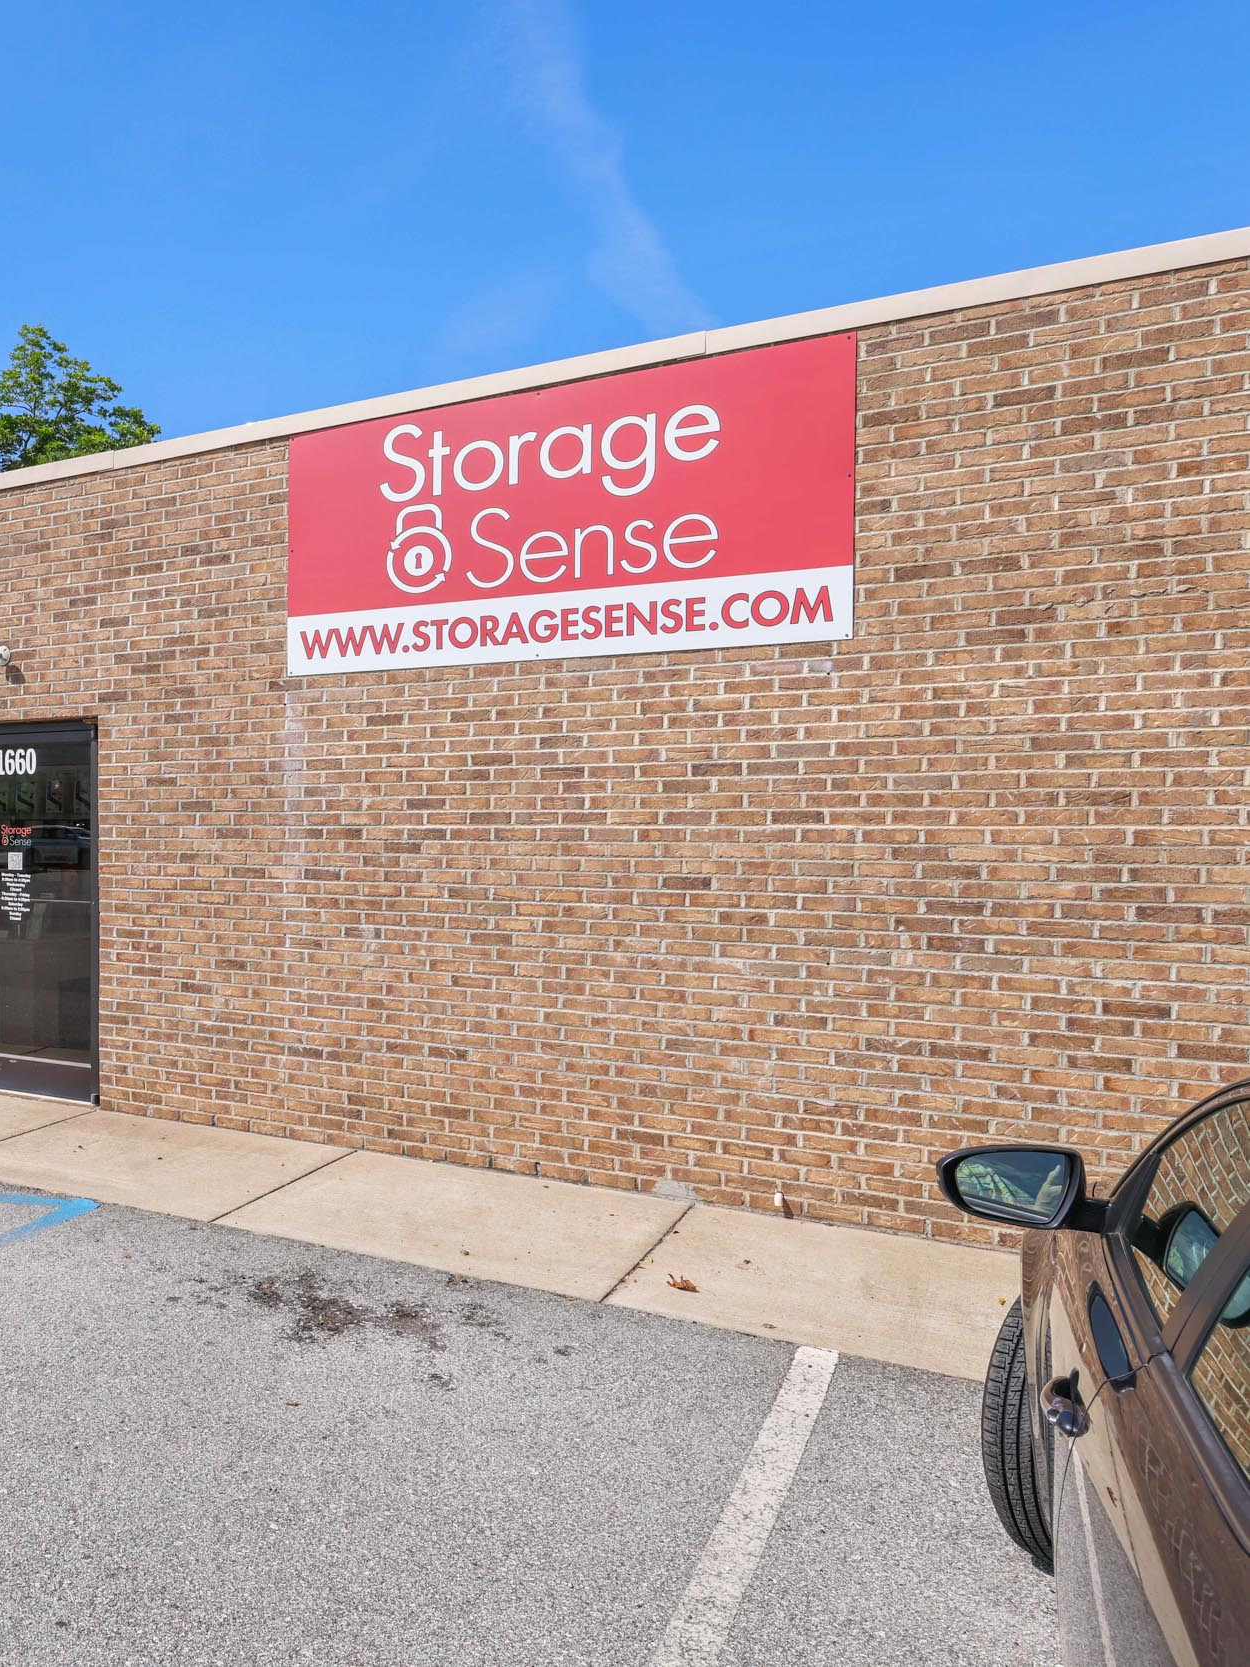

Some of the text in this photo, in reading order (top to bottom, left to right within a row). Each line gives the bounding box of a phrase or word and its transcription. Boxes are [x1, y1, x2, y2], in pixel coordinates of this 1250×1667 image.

[380, 404, 721, 502] Storage
[466, 507, 719, 589] Sense
[300, 586, 834, 660] WWW.STORAGESENSE.COM
[1, 824, 31, 837] Storage
[9, 835, 31, 846] Sense
